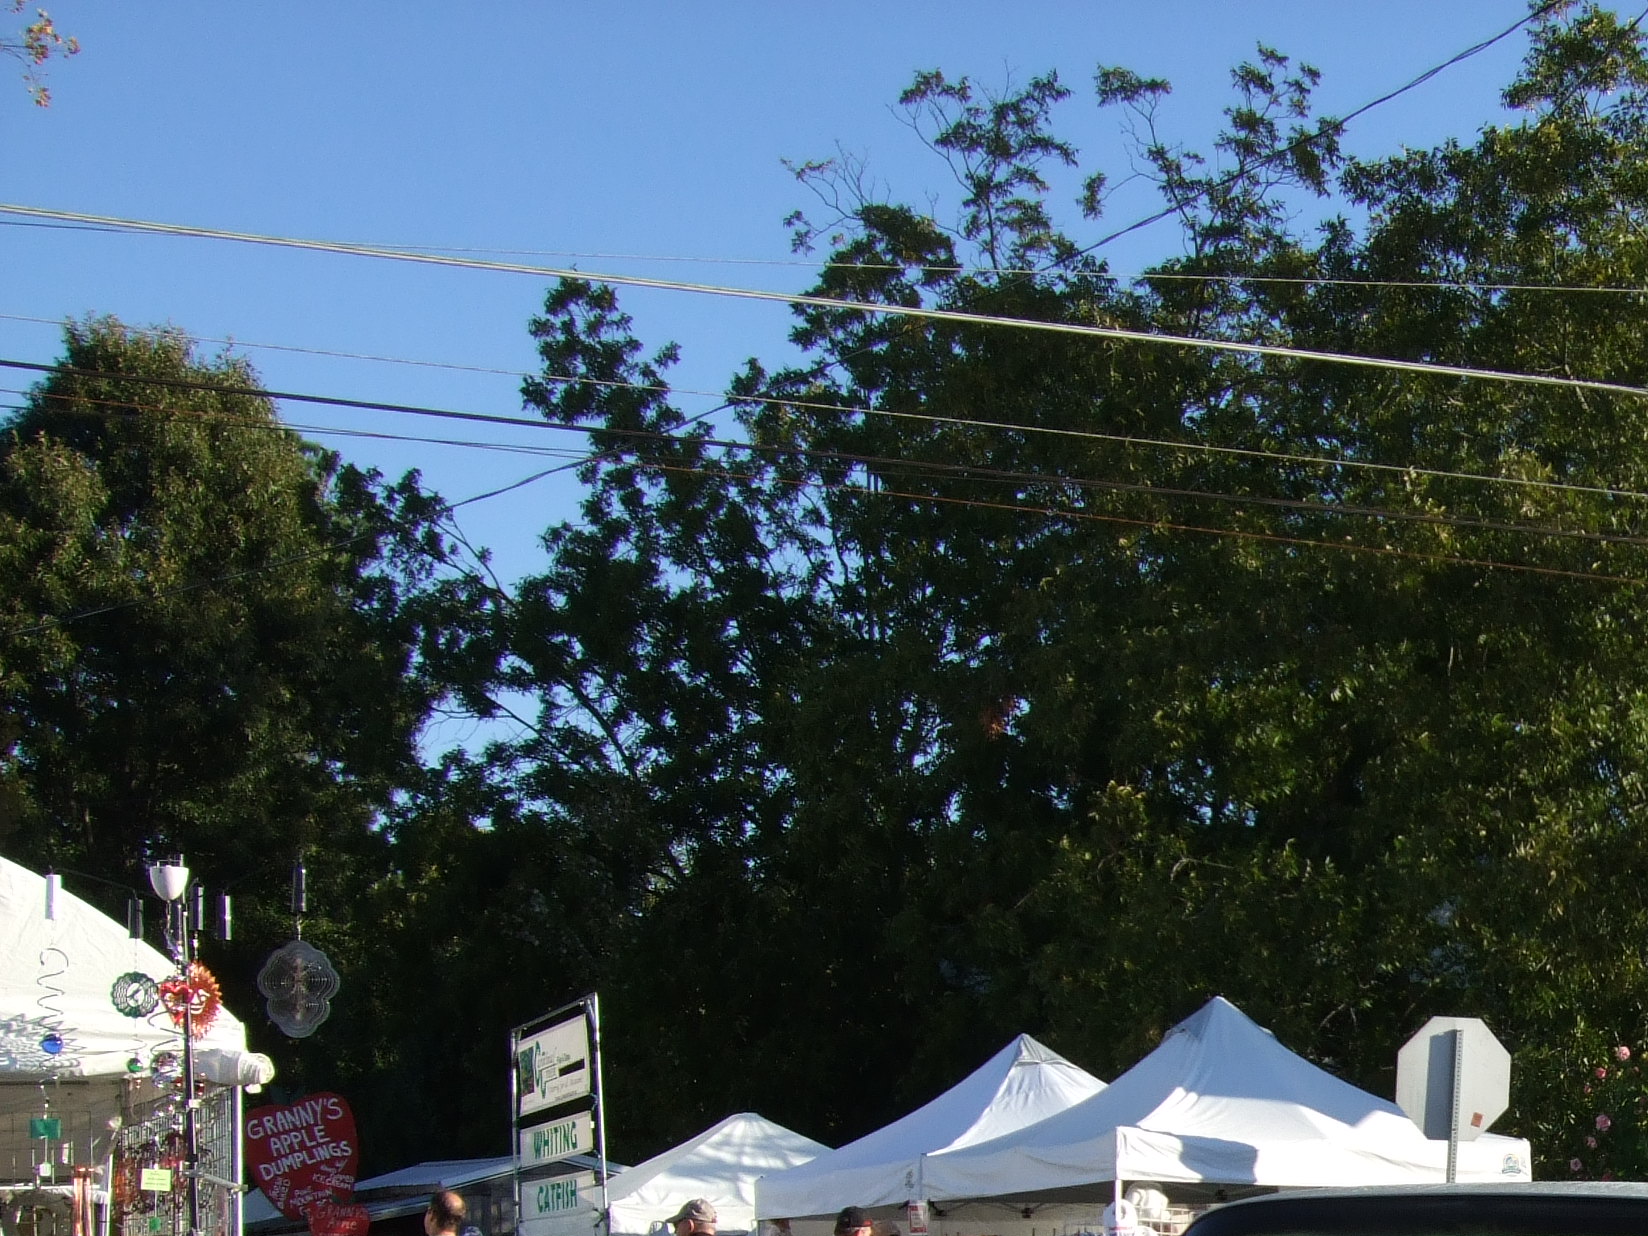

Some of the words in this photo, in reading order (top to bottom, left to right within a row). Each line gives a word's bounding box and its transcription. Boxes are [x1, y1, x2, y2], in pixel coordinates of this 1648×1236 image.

[247, 1098, 344, 1139] GRANNY'S
[270, 1125, 331, 1157] APPLE
[532, 1120, 578, 1160] WHITING
[259, 1141, 352, 1180] DUMPLINGS
[537, 1178, 578, 1214] CATFISH
